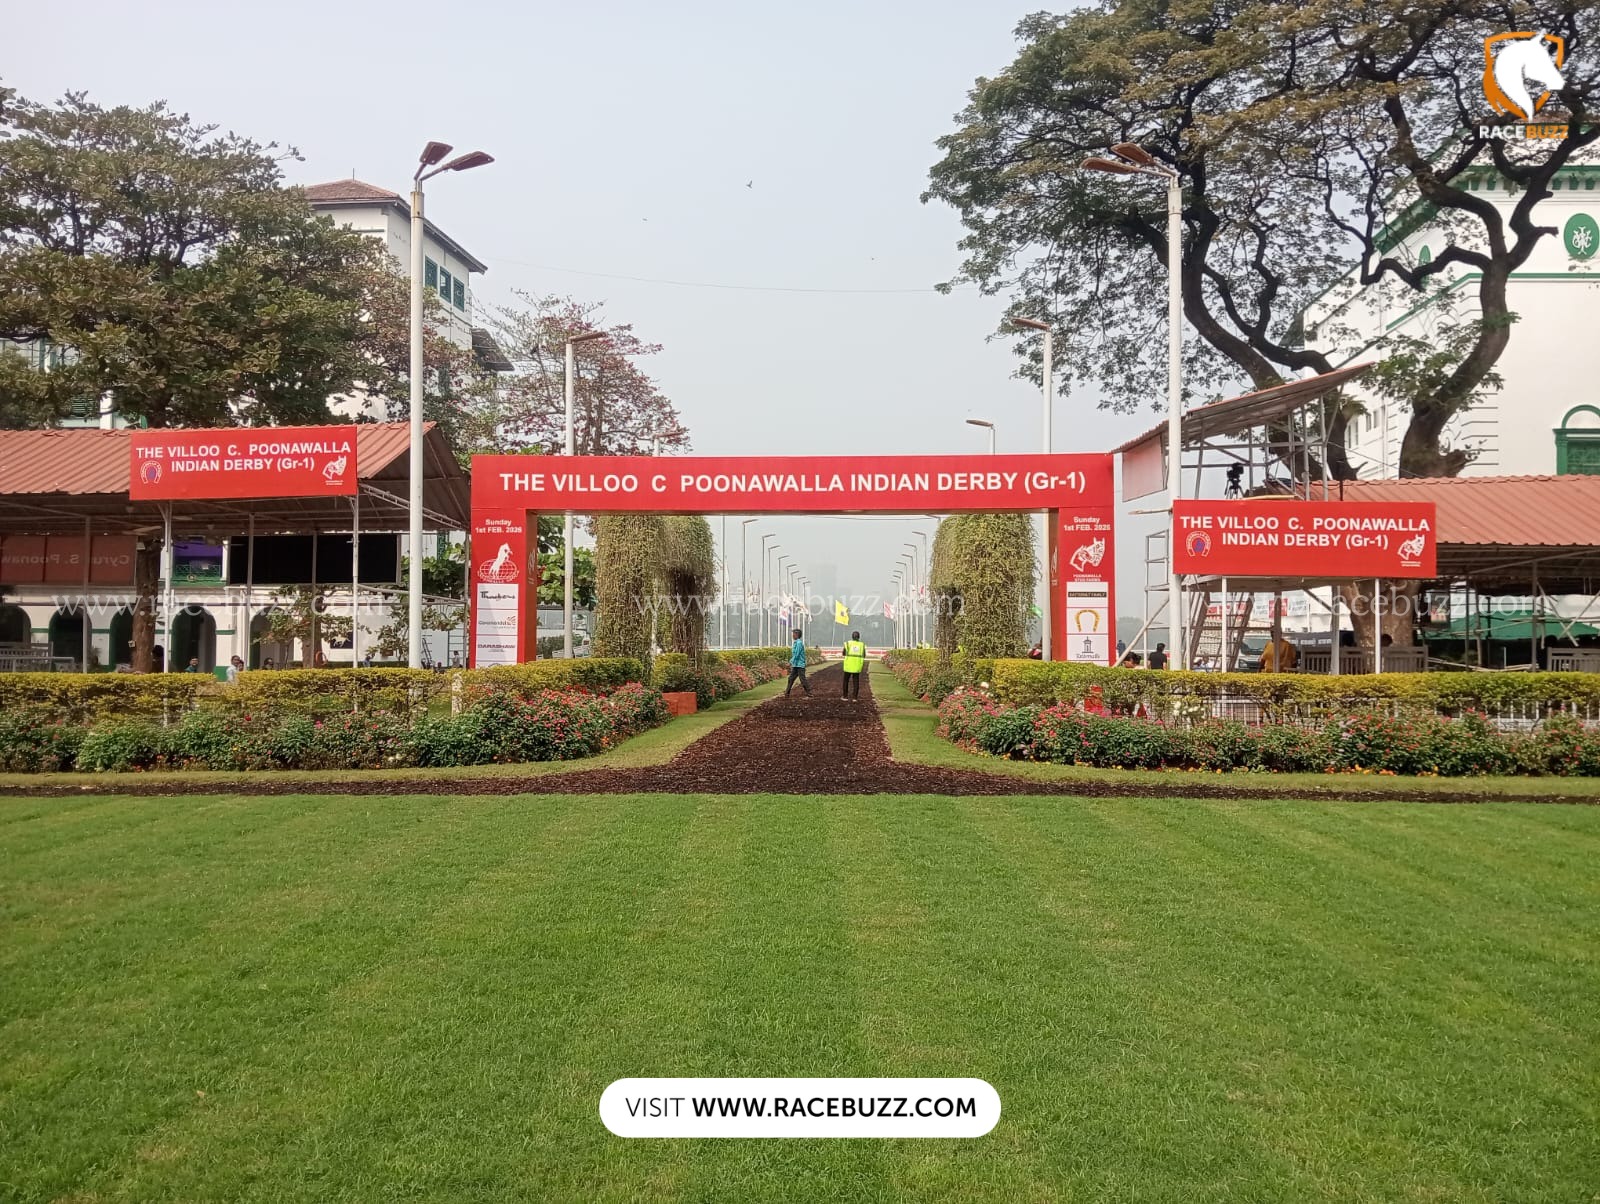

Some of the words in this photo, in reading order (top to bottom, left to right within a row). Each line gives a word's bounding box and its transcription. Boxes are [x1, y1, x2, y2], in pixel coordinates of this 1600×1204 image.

[136, 446, 164, 459] THE
[168, 445, 220, 458] VILLOO
[227, 444, 241, 456] C.
[249, 441, 351, 456] POONAWALLA
[171, 458, 220, 472] INDIAN
[224, 457, 273, 471] DERBY
[277, 457, 315, 472] (Gr-1)
[499, 473, 545, 492] THE
[551, 474, 638, 492] VILLOO
[651, 474, 667, 493] C
[680, 474, 845, 493] POONAWALLA
[850, 473, 929, 492] INDIAN
[937, 472, 1018, 491] DERBY
[1024, 471, 1086, 494] (Gr-1)
[485, 519, 512, 527] Sunday
[1073, 516, 1100, 524] Sunday
[1180, 516, 1213, 529] THE
[1217, 516, 1279, 530] VILLOO
[1288, 516, 1304, 530] C.
[1313, 518, 1430, 532] POONAWALLA
[1222, 532, 1279, 546] INDIAN
[1284, 532, 1342, 547] DERBY
[1345, 533, 1389, 550] (Gr-1)
